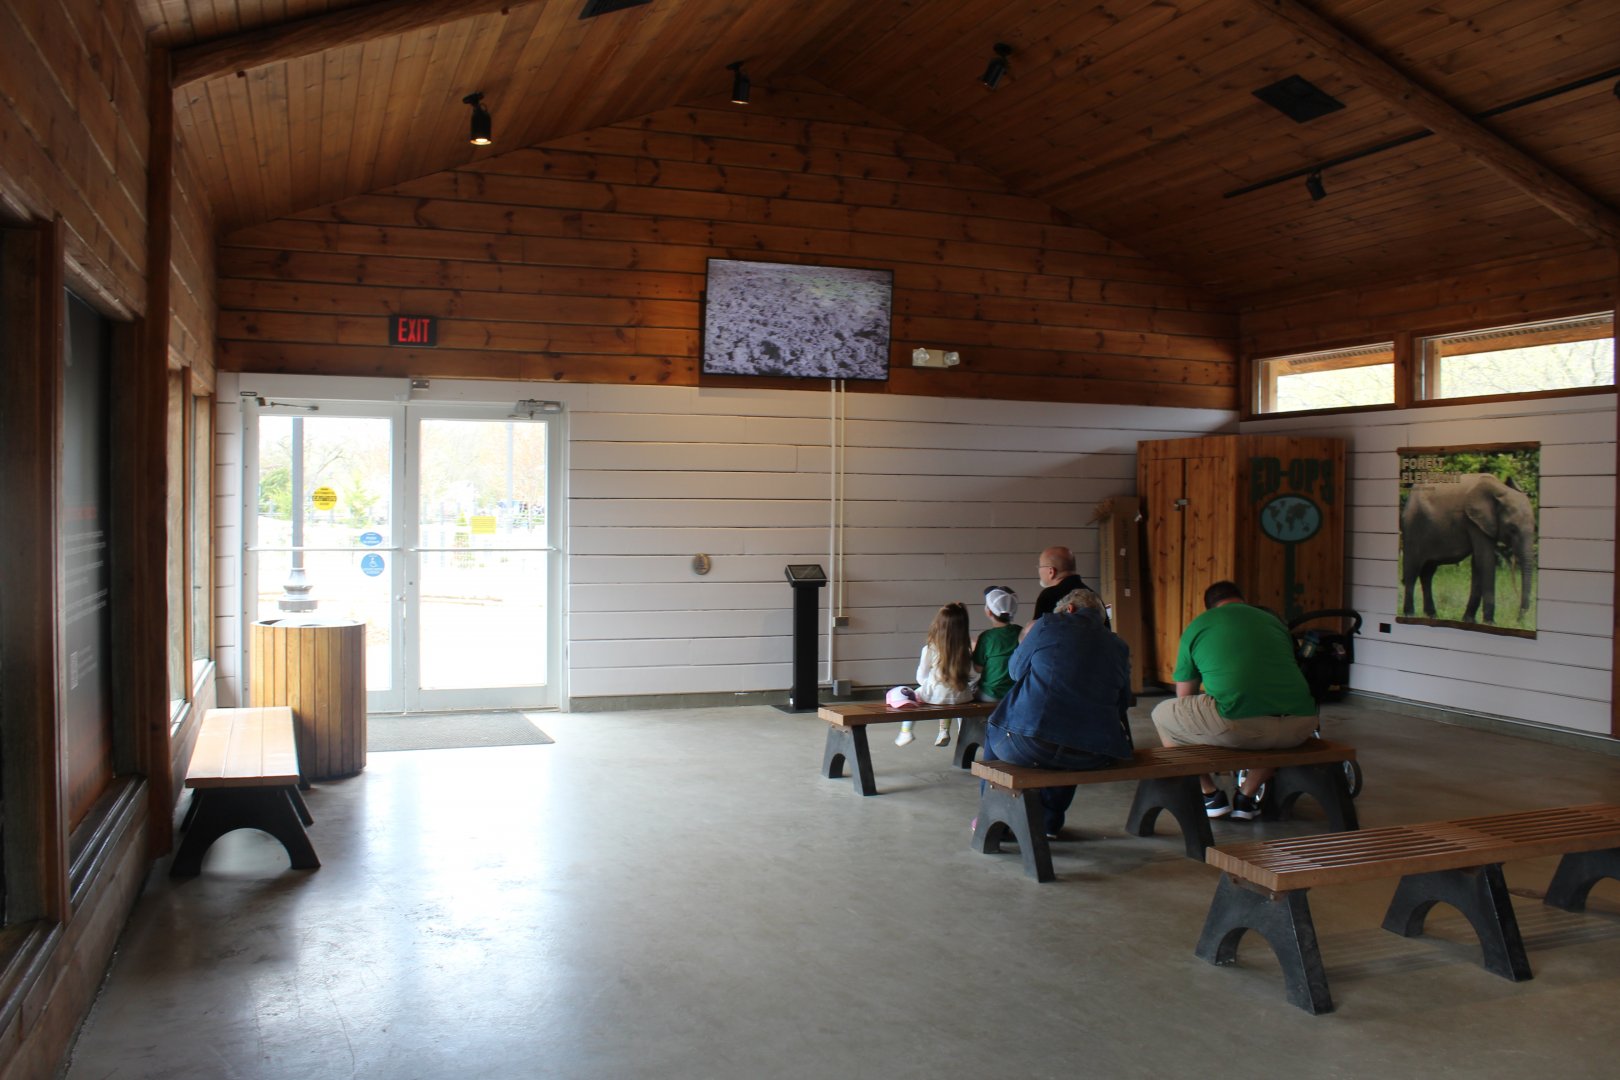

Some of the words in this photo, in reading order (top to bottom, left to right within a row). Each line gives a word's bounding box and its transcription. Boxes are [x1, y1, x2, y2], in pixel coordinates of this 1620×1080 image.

[397, 317, 430, 343] EXIT
[1401, 457, 1445, 470] FOREST
[1249, 456, 1334, 505] ED-OPS
